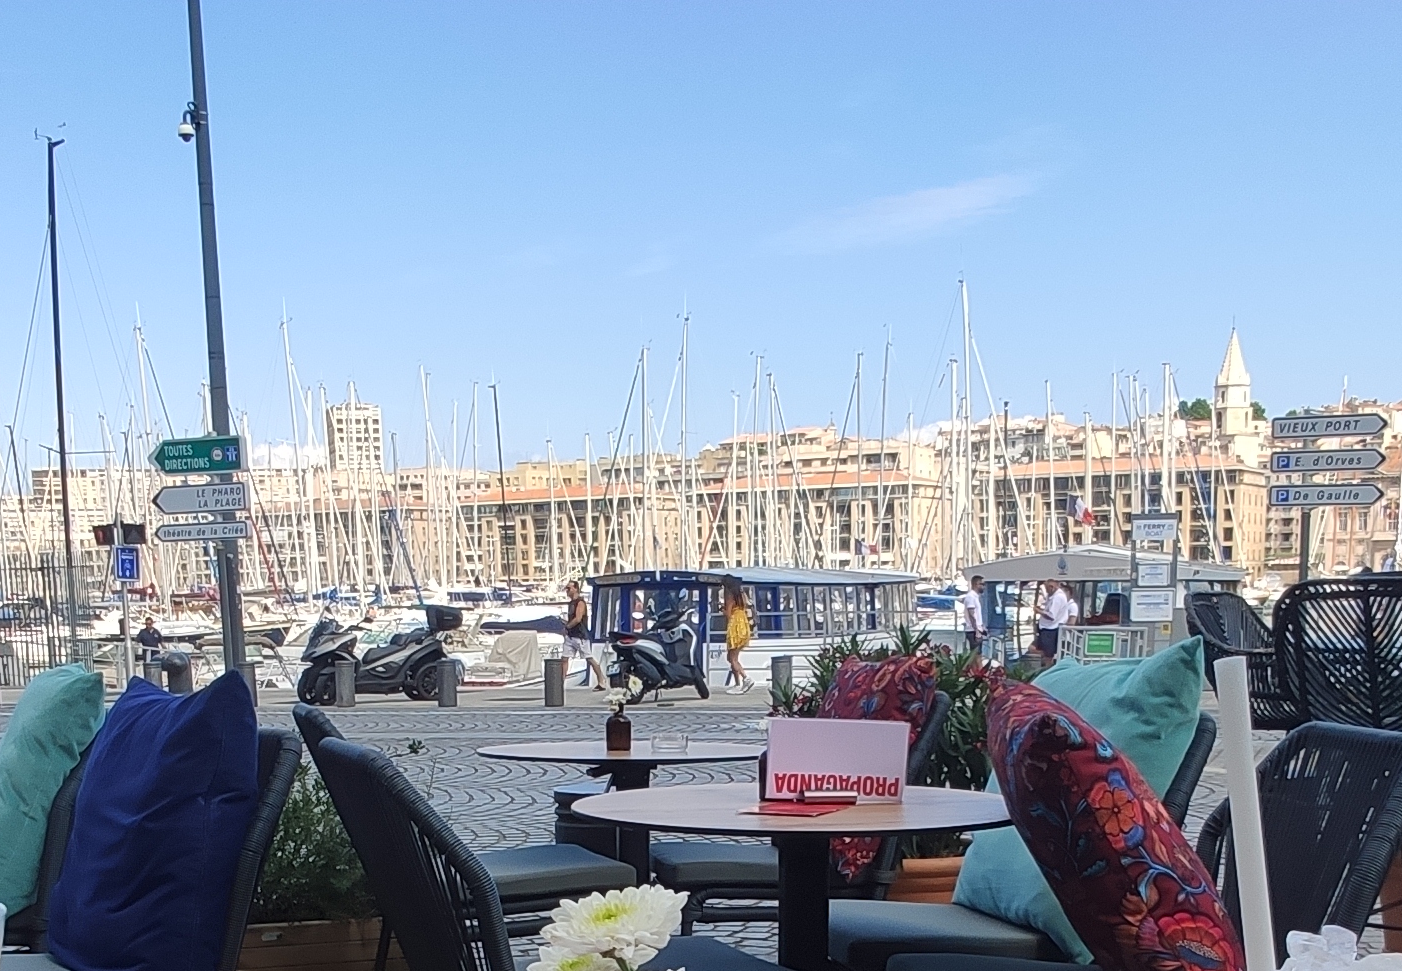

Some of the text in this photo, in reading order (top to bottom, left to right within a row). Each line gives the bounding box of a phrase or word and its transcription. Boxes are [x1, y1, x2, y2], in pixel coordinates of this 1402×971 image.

[1278, 419, 1361, 434] VIEUX PORT
[163, 444, 194, 457] TOUTES
[164, 457, 210, 471] DIRECTIONS
[1294, 456, 1305, 467] E.
[1312, 454, 1362, 466] d'Orves
[196, 486, 242, 498] LE PHARO
[1292, 490, 1309, 501] De
[1316, 489, 1360, 501] Gaulle
[198, 497, 243, 508] LA PLAGE
[196, 527, 206, 536] de
[210, 526, 218, 535] la
[1143, 523, 1166, 531] FERRY
[1144, 530, 1164, 538] BOAT
[773, 772, 901, 798] PROPAGANDA
